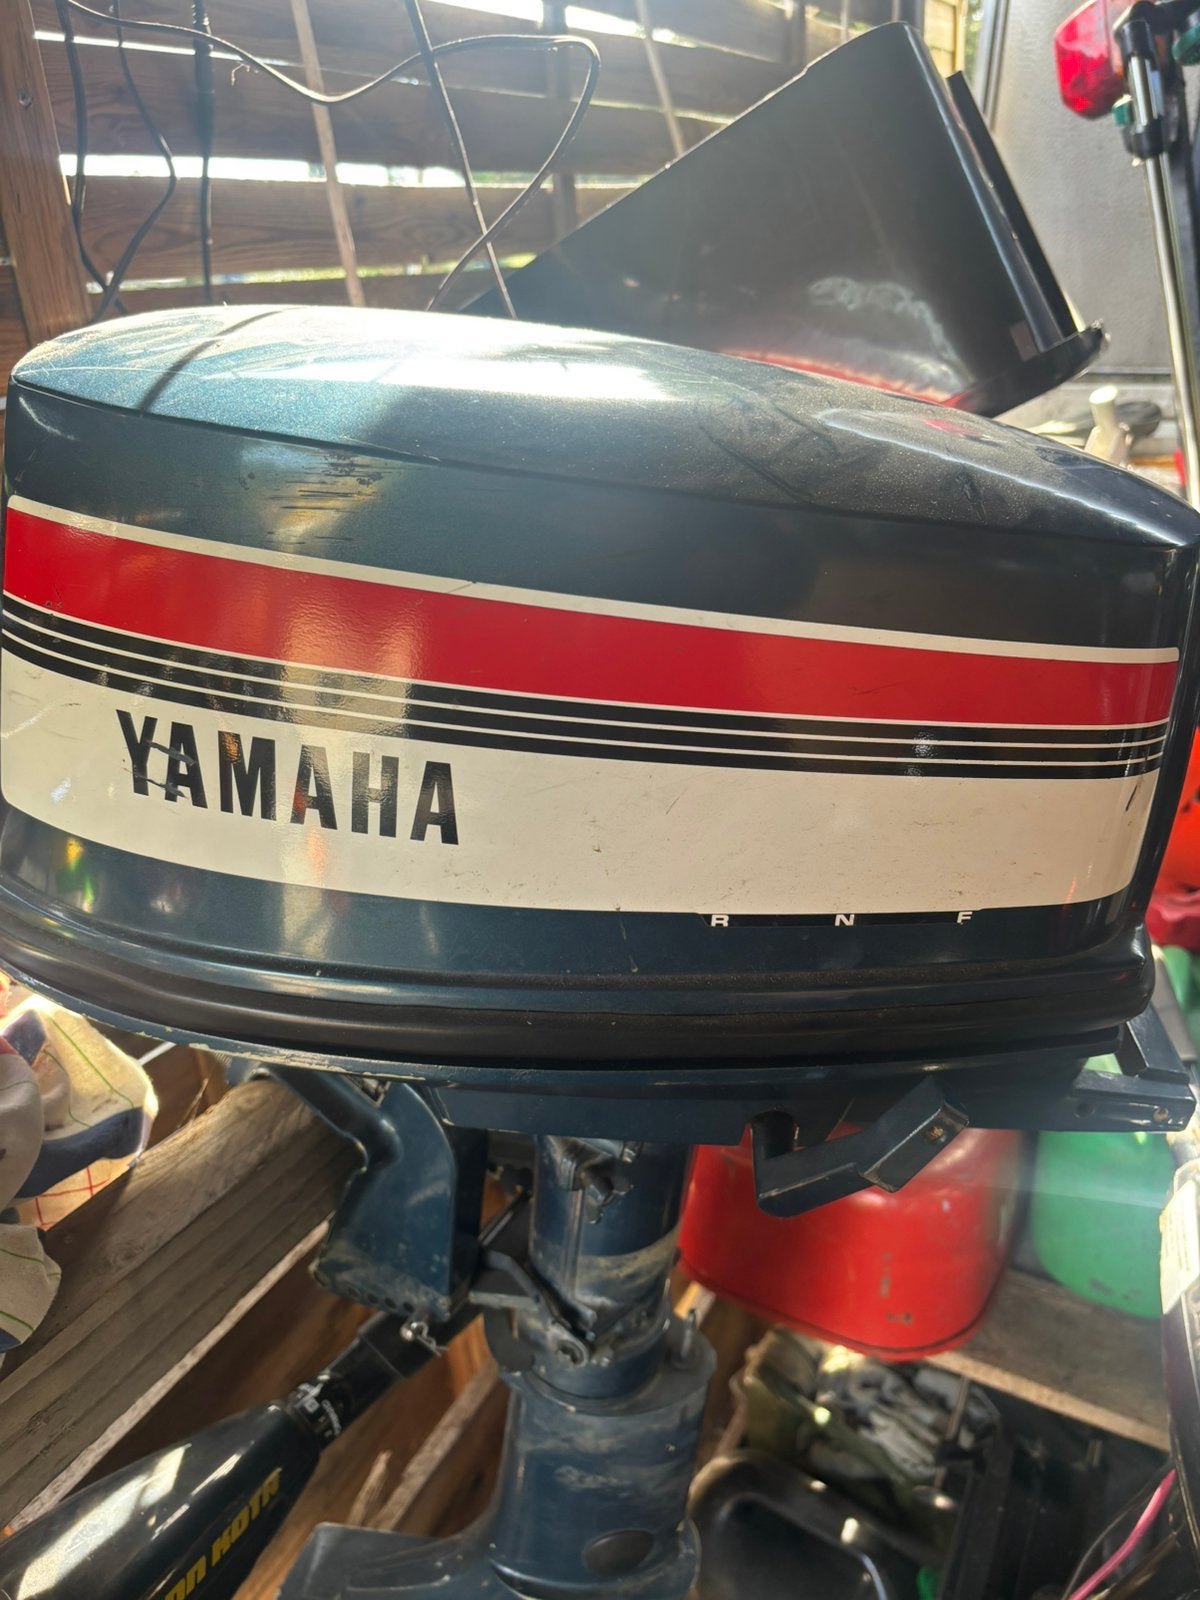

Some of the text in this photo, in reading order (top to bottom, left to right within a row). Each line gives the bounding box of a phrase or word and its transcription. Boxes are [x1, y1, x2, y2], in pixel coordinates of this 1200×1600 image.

[115, 708, 460, 846] YAMAHA
[710, 911, 973, 928] R N F
